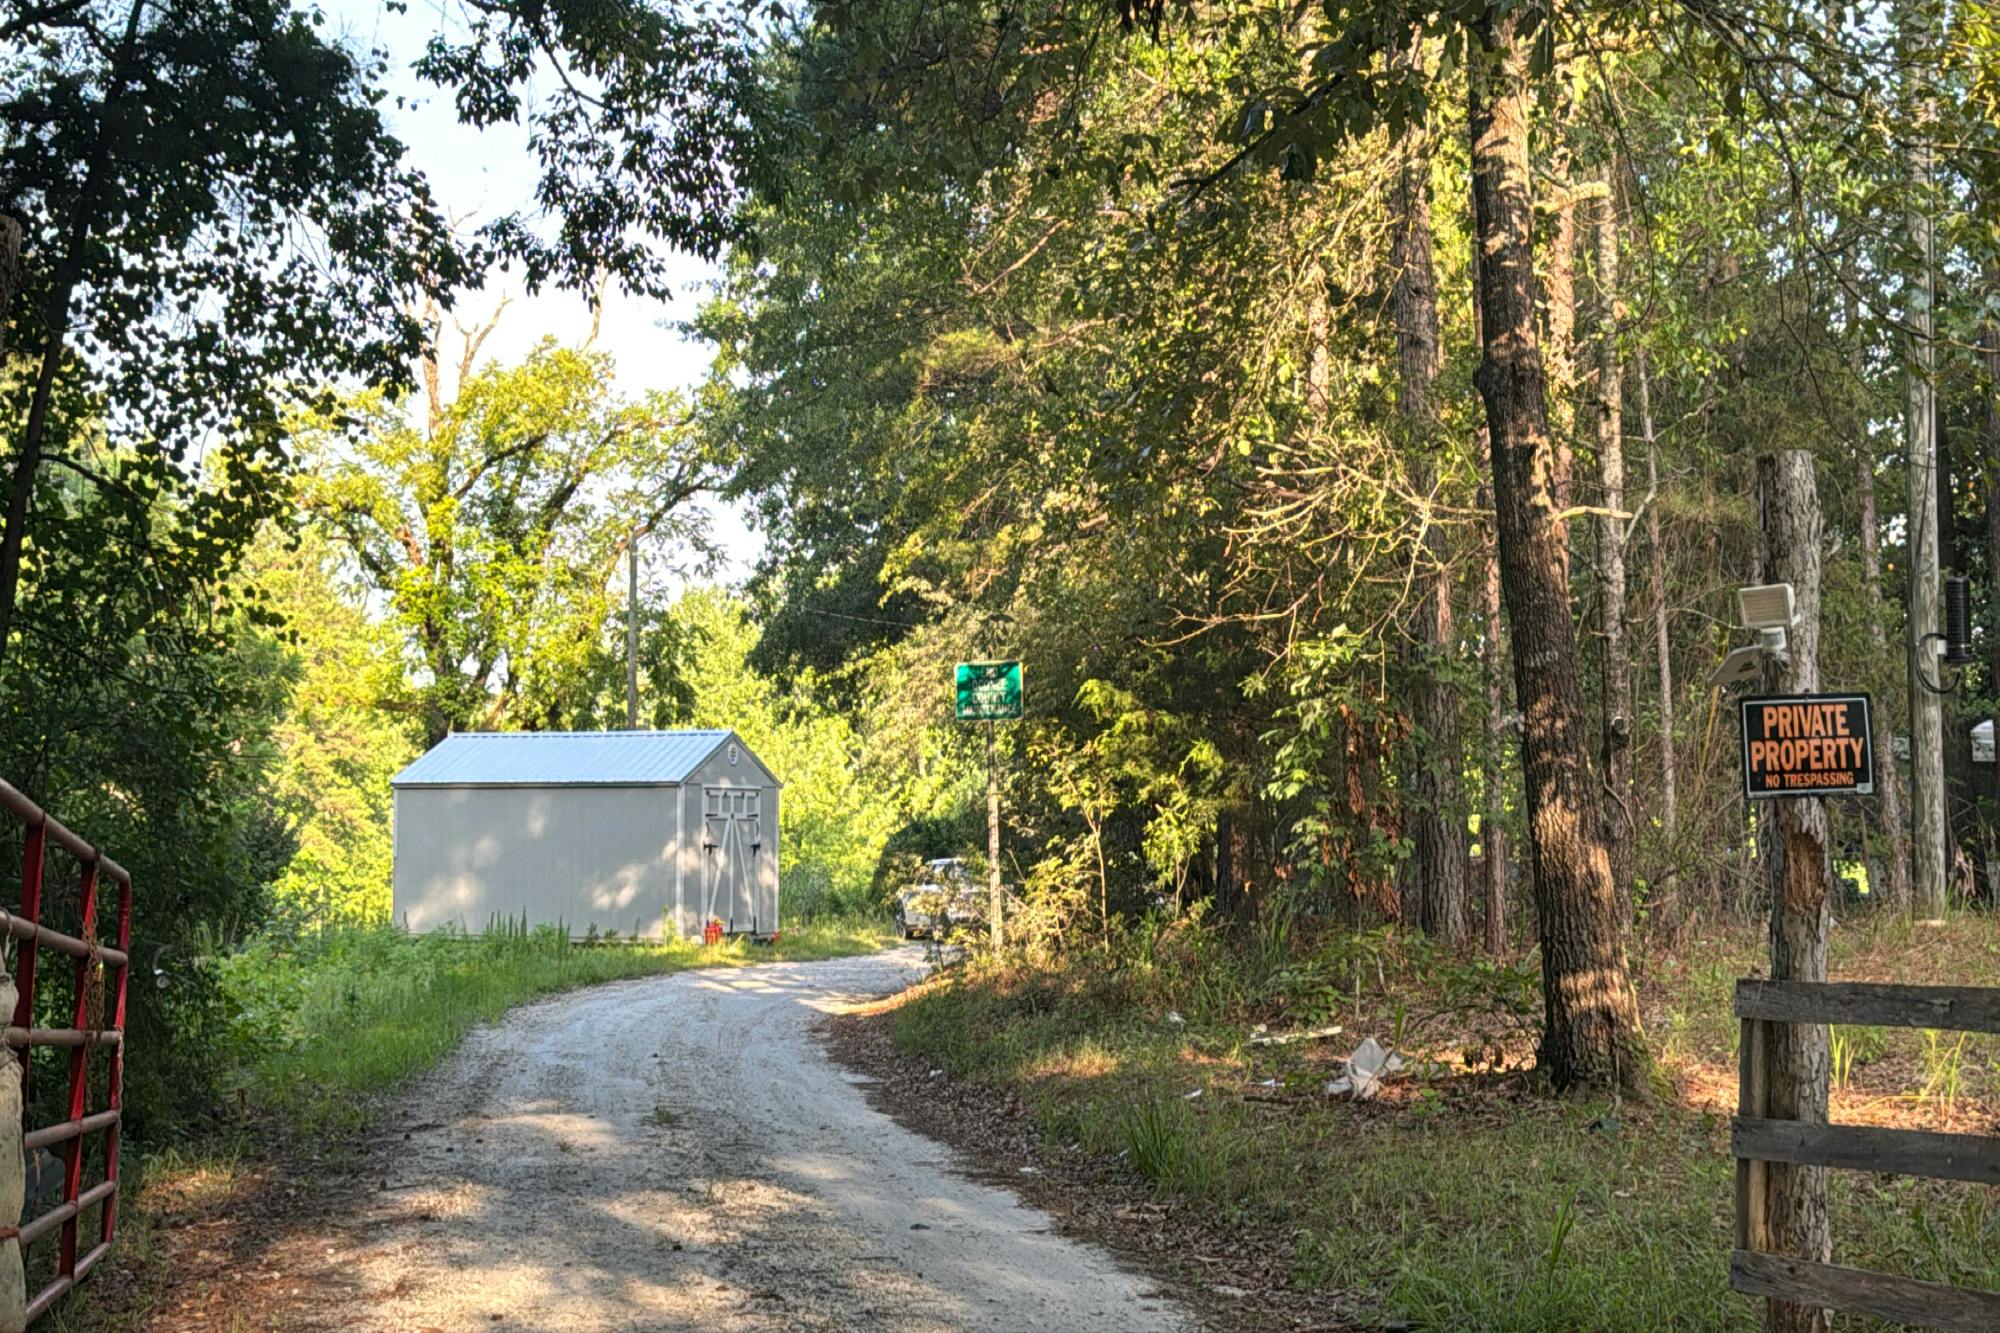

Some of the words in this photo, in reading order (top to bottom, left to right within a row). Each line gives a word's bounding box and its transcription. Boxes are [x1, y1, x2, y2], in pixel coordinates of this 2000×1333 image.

[972, 691, 1006, 704] COUNTY
[961, 703, 1017, 717] MAINTENANCE
[1763, 704, 1850, 738] PRIVATE
[1750, 737, 1864, 772] PROPERTY
[1765, 774, 1780, 788] NO
[1784, 771, 1854, 788] TRESPASSING
